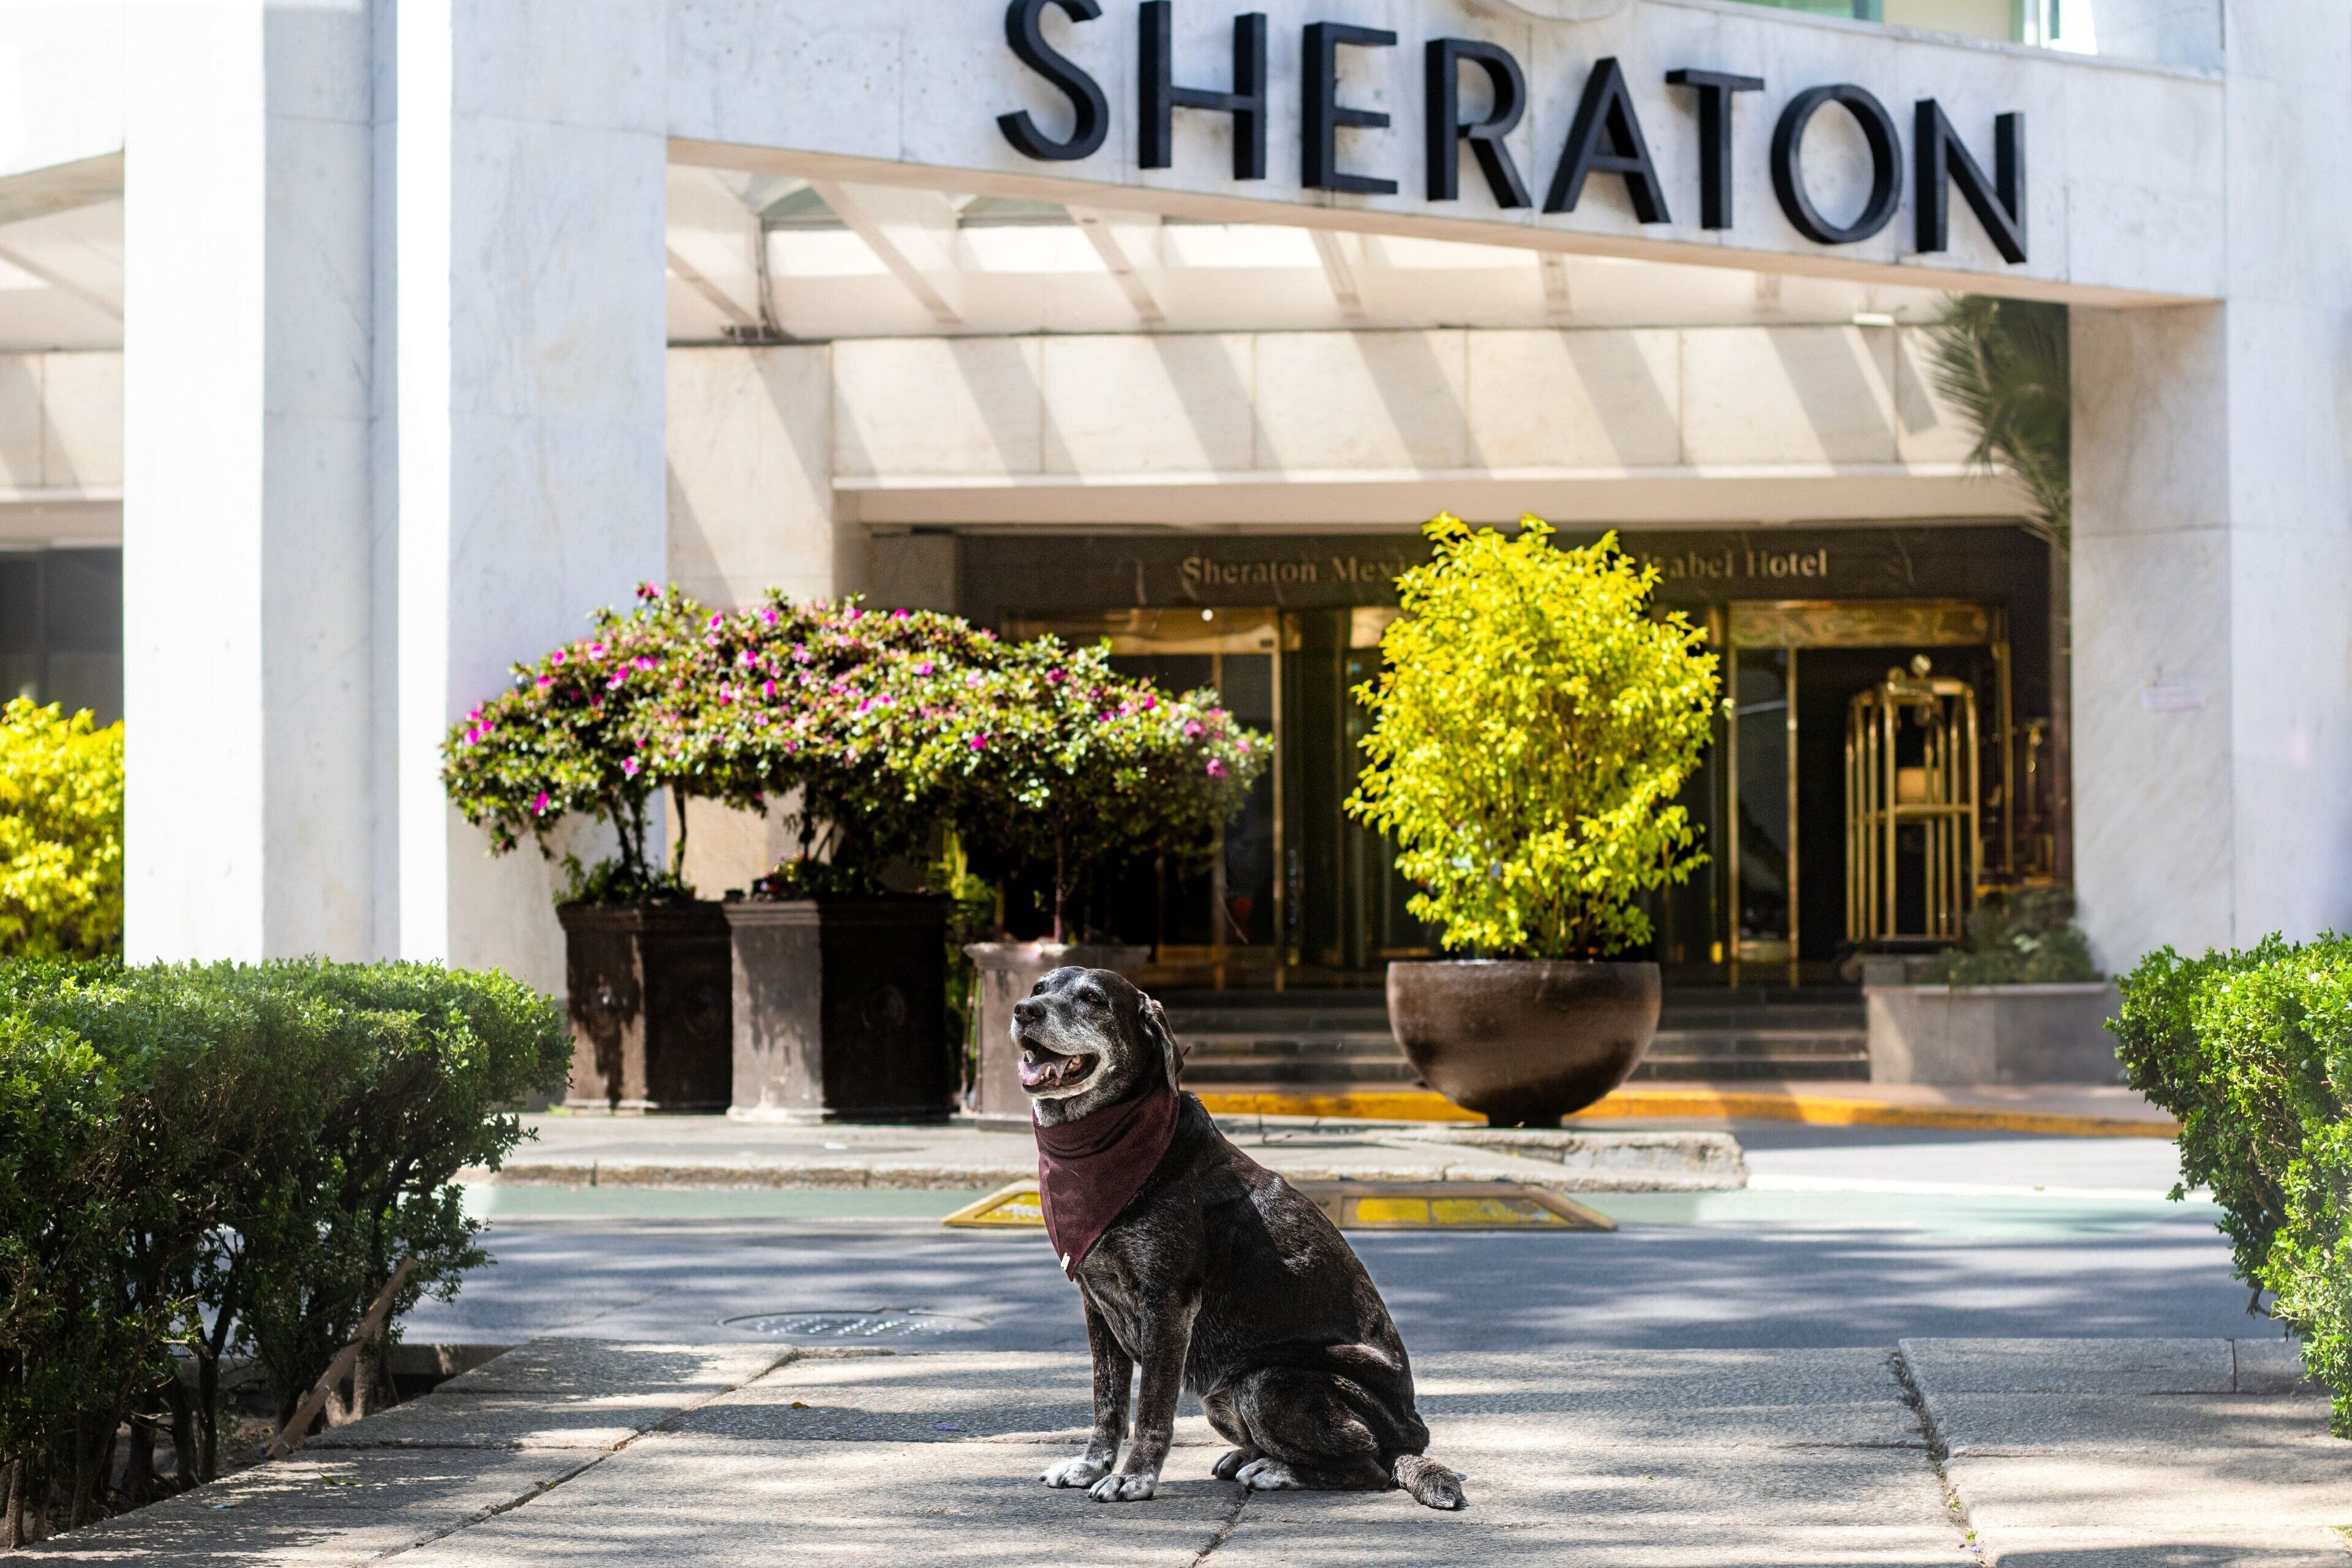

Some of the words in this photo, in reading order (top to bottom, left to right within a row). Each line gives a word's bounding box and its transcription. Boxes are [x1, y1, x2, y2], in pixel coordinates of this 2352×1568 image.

[997, 0, 2026, 264] SHERATON
[1182, 555, 1317, 582] Sheraton
[1747, 548, 1828, 577] Hotel
